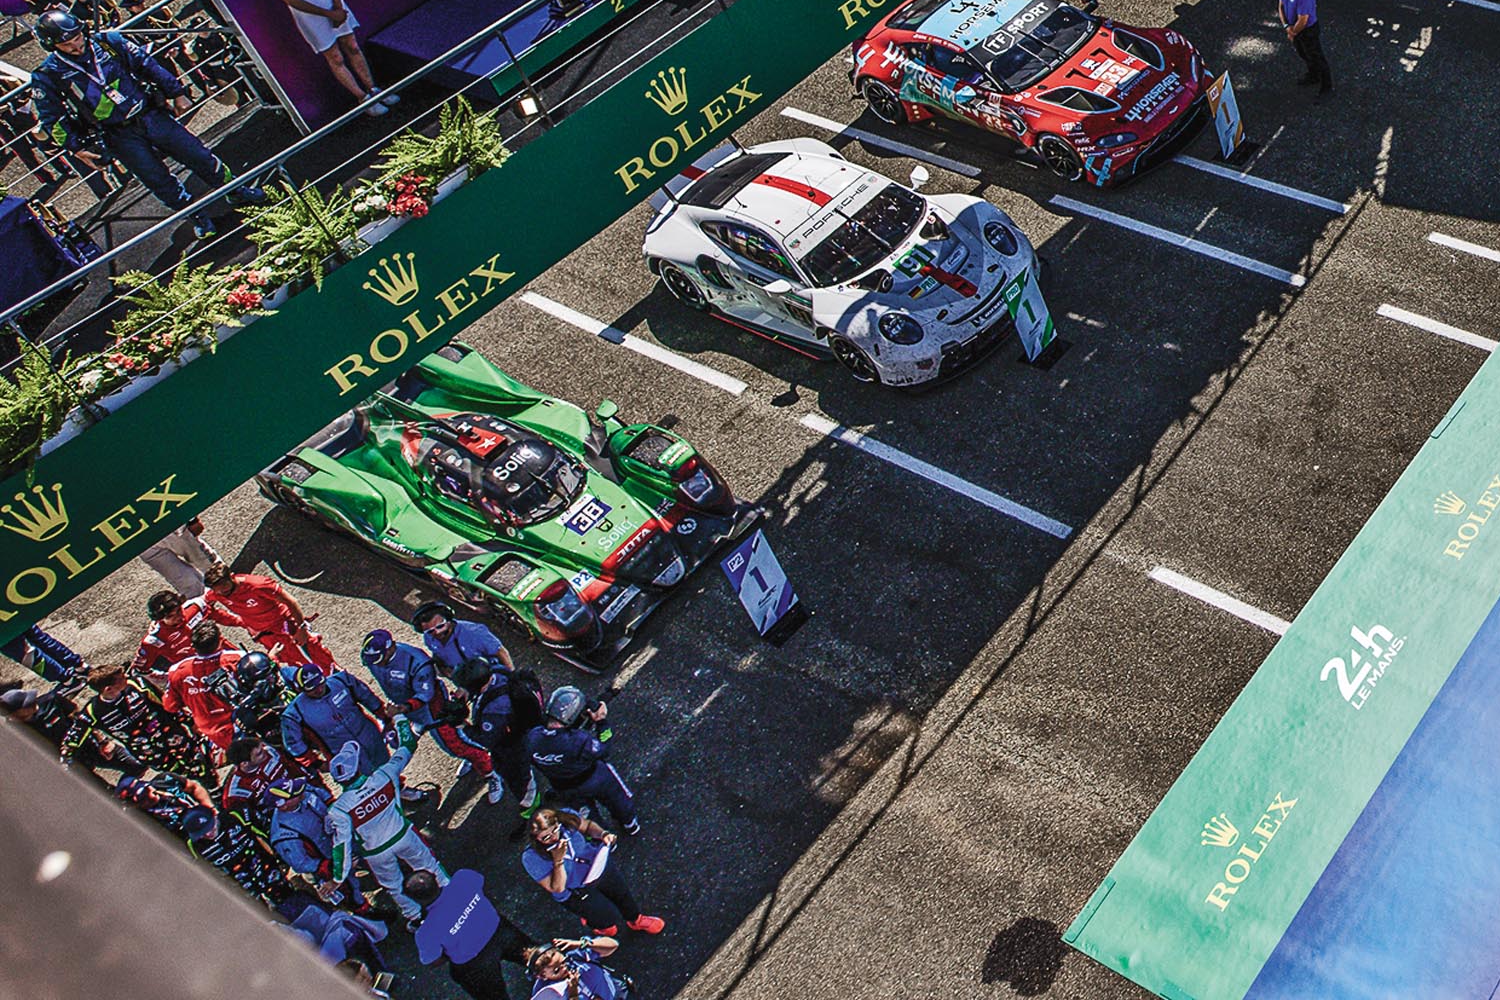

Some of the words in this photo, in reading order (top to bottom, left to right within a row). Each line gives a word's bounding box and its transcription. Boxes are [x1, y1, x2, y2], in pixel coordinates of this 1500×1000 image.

[989, 31, 1006, 52] TF
[1009, 1, 1050, 35] SPORT
[1107, 63, 1129, 85] 33
[615, 75, 761, 194] ROLEX
[801, 182, 869, 240] PORSCHE
[1006, 286, 1020, 302] PRO
[1022, 298, 1037, 325] 1
[325, 253, 514, 395] ROLEX
[491, 446, 541, 482] Soliq
[570, 503, 605, 533] 38
[0, 475, 197, 622] OLEX
[616, 526, 651, 562] JOTA
[572, 571, 594, 588] P2
[728, 556, 744, 570] P2
[748, 566, 769, 593] 1
[1320, 624, 1394, 702] 24h
[1351, 688, 1371, 710] LE
[1367, 637, 1405, 688] MANS
[533, 752, 564, 763] WEC
[355, 793, 388, 819] Soliq
[1205, 791, 1299, 911] ROLEX
